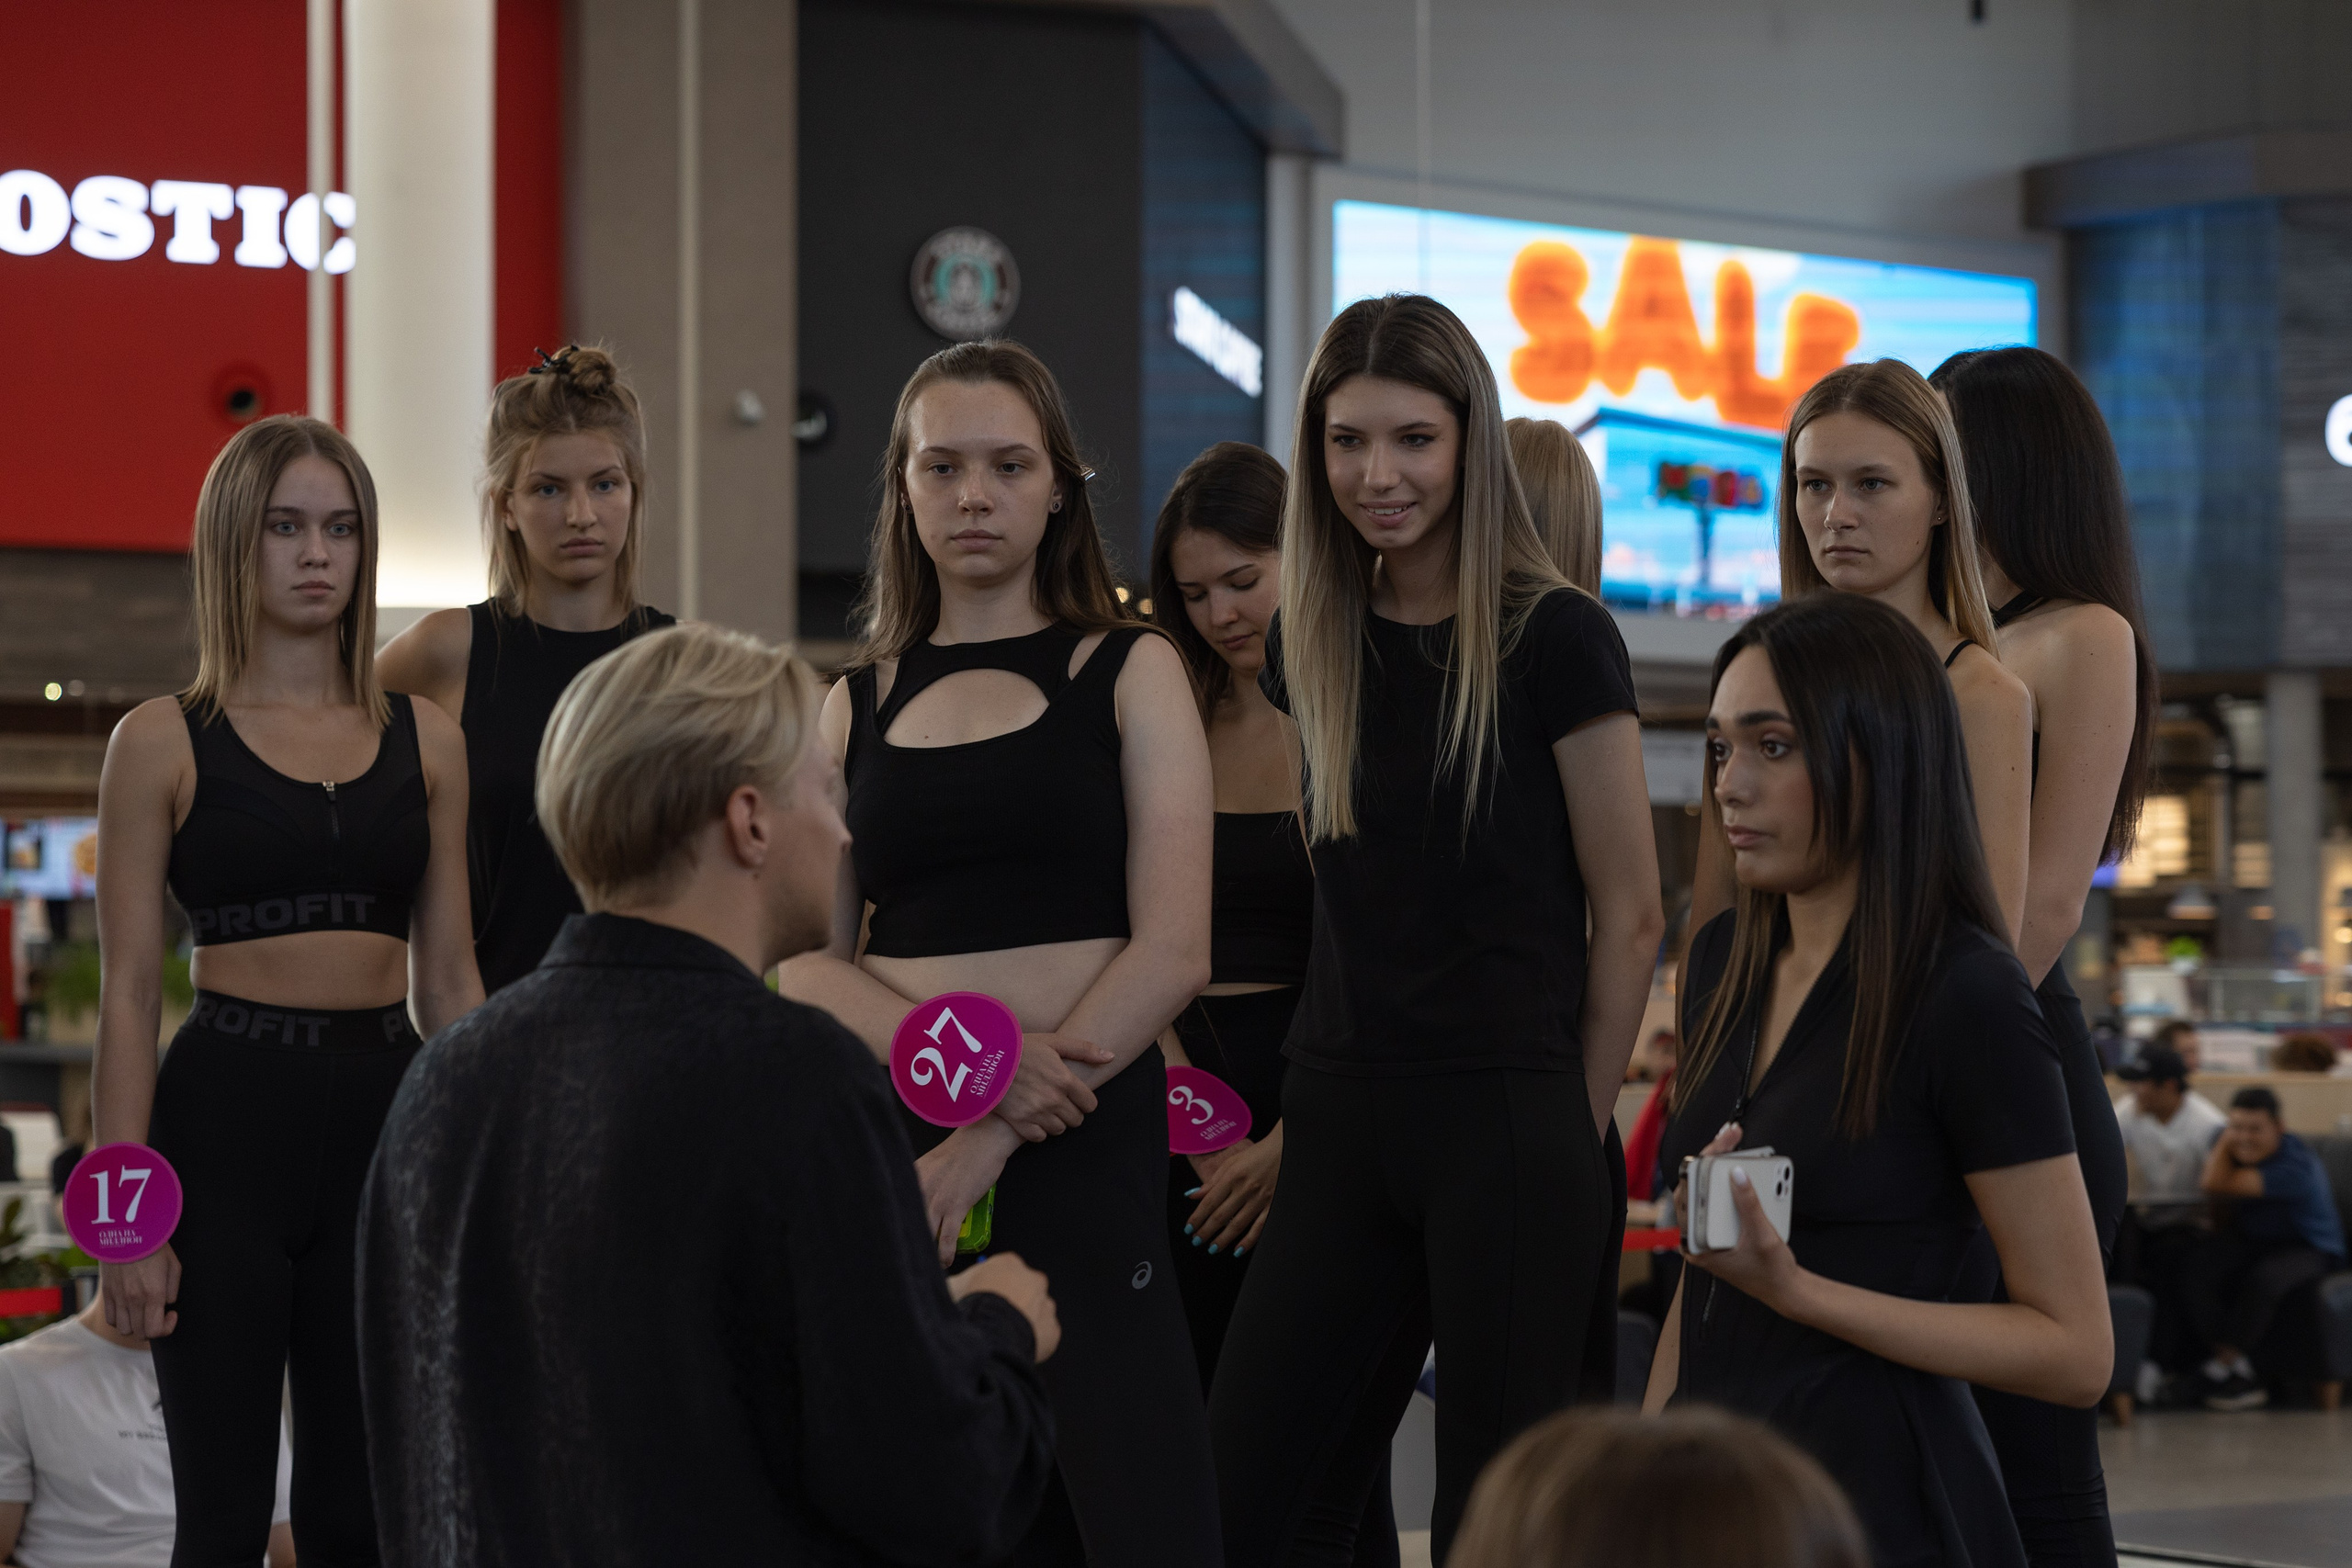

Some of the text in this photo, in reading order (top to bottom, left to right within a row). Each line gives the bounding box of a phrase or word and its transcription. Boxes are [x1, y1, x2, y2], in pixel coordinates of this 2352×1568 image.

[0, 169, 356, 276] OSTIC
[189, 892, 376, 940] PROFIT
[910, 1007, 982, 1103] 27
[969, 1066, 987, 1095] ОДНА
[983, 1054, 995, 1068] НА
[976, 1049, 1005, 1098] МИЛЛИОН
[1168, 1085, 1214, 1125] 3
[89, 1164, 153, 1224] 17
